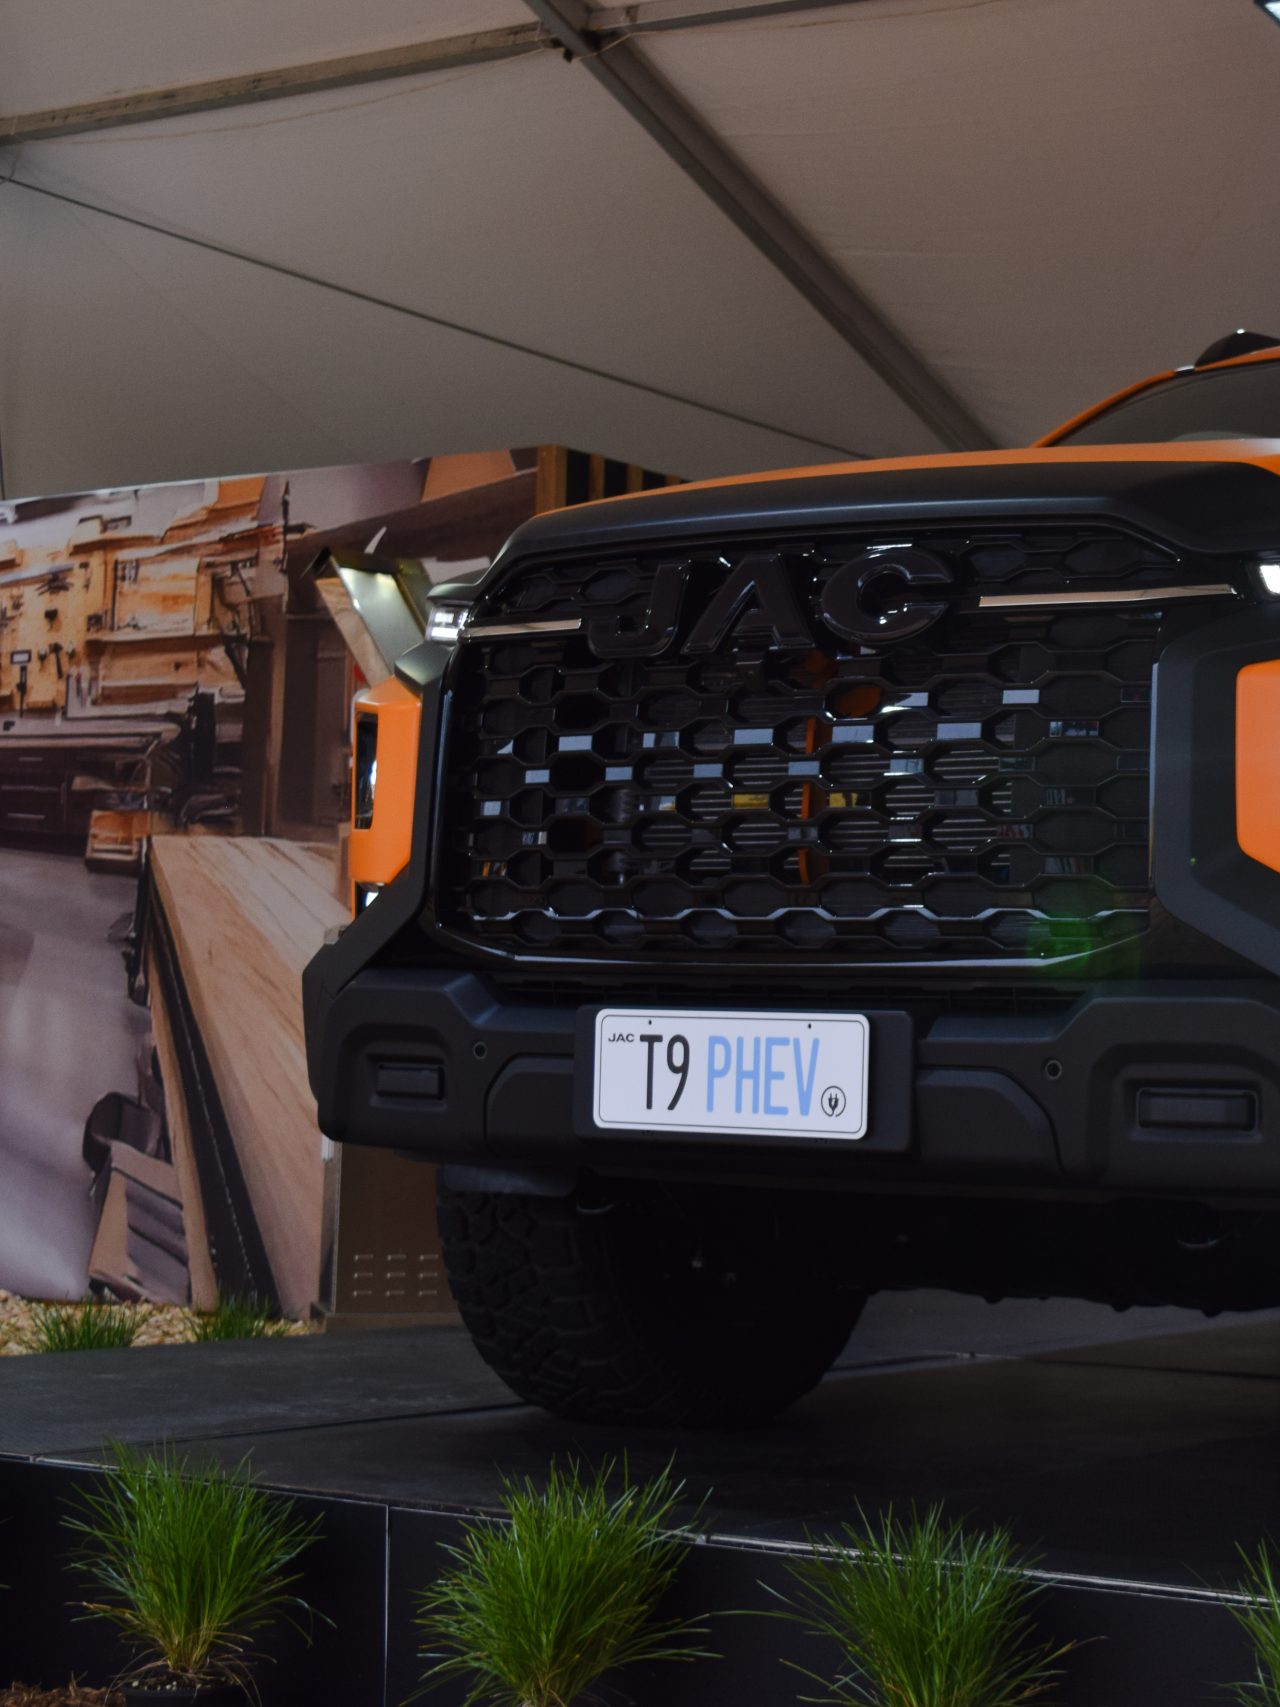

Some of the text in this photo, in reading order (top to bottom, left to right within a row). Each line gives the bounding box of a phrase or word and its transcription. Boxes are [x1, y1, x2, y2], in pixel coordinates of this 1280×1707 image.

[587, 548, 952, 658] JAC
[607, 1032, 636, 1043] JAC
[639, 1034, 820, 1117] T9 PHEV
